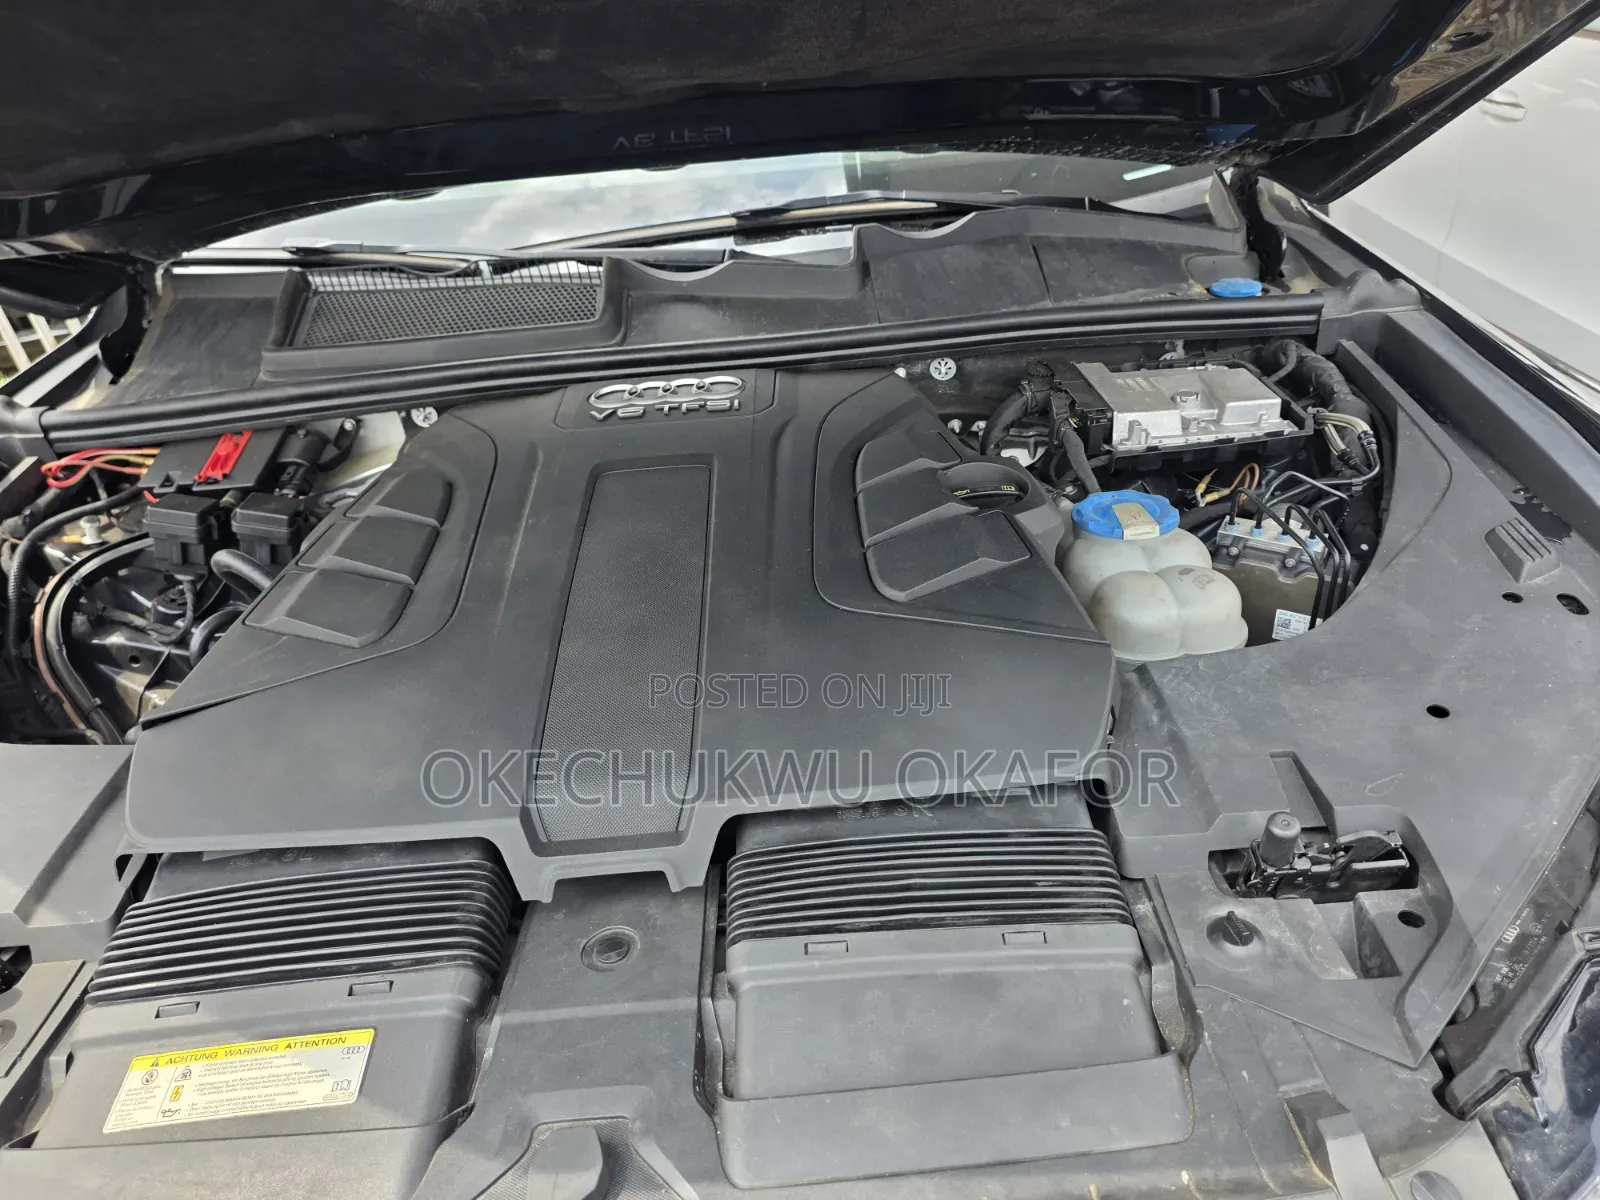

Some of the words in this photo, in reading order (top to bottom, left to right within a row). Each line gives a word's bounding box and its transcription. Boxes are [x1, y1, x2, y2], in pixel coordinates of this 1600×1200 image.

[588, 405, 645, 421] V6
[654, 398, 740, 416] TFSI
[164, 1051, 218, 1066] ACHTUNG
[223, 1044, 279, 1057] WARNING
[284, 1036, 347, 1051] ATTENTION
